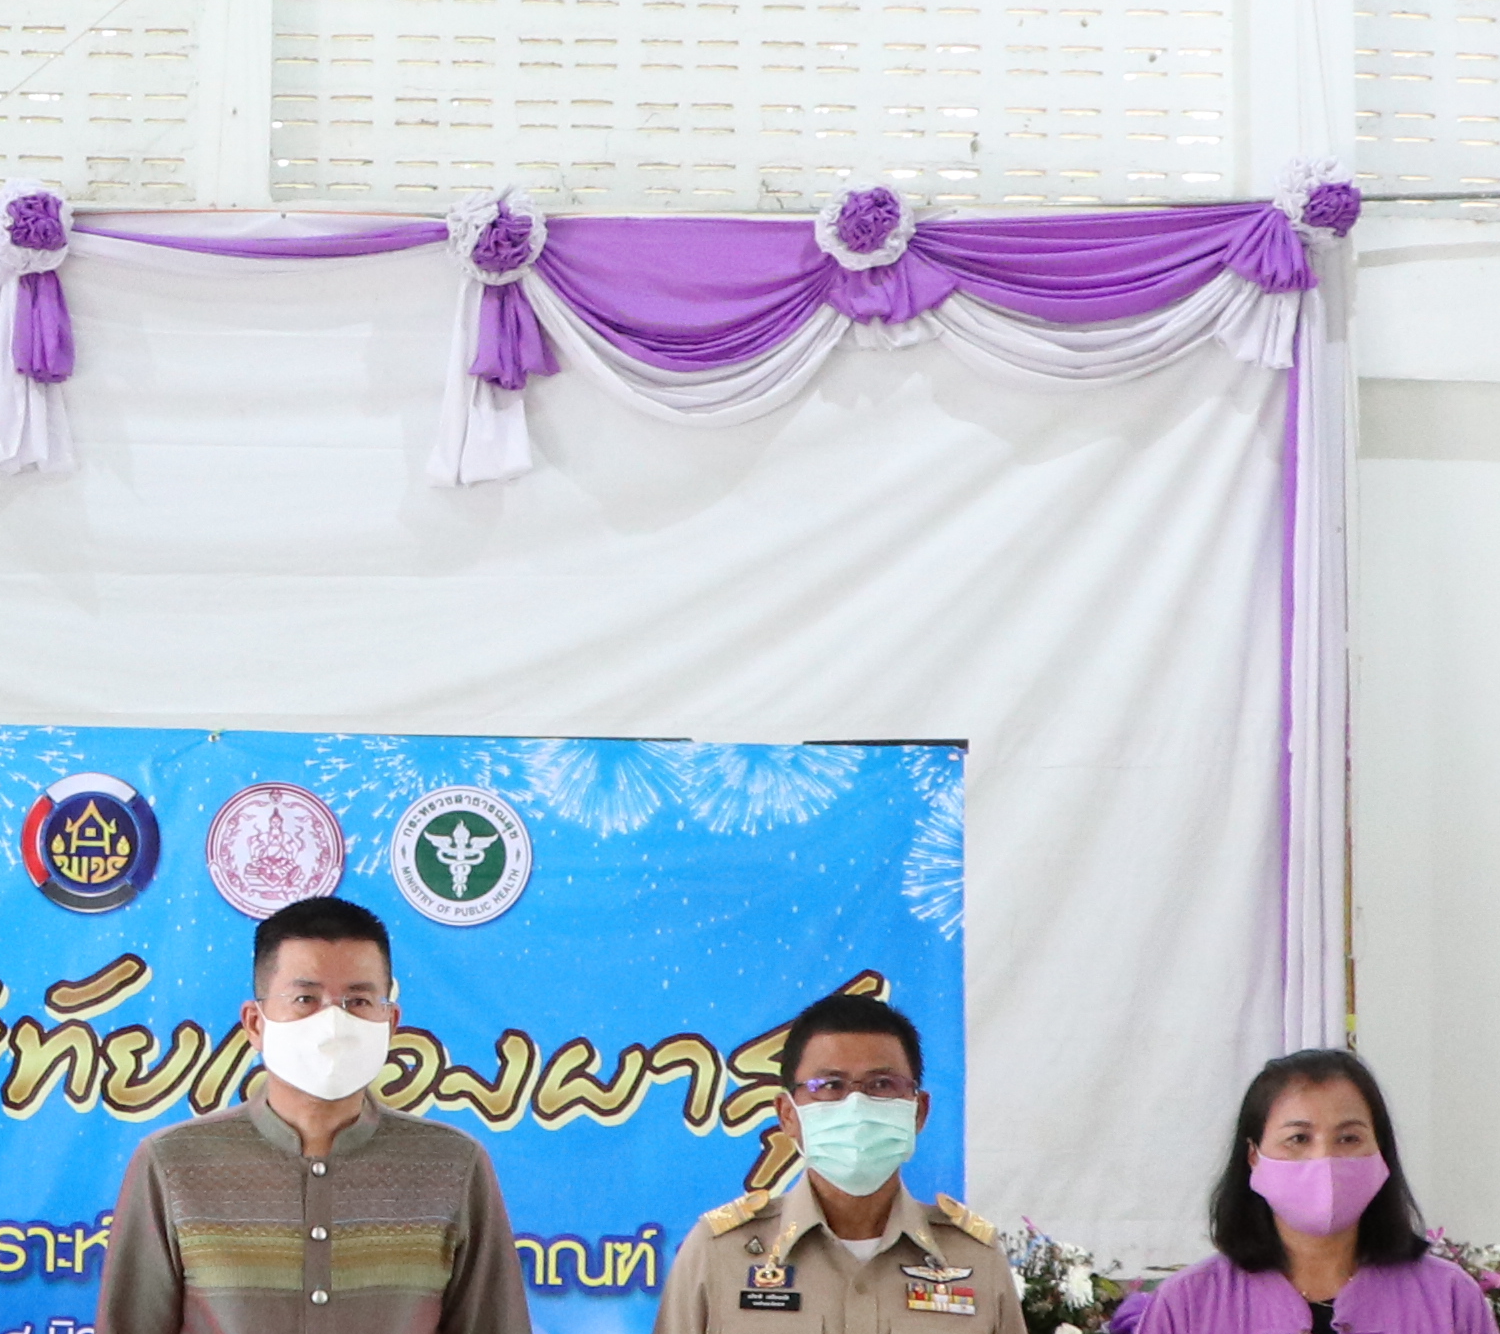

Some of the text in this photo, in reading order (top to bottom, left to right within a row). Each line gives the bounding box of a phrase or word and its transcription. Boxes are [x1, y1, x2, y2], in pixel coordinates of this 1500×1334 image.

[402, 866, 519, 916] MINISTRY OF PUBLIC HEALTH
